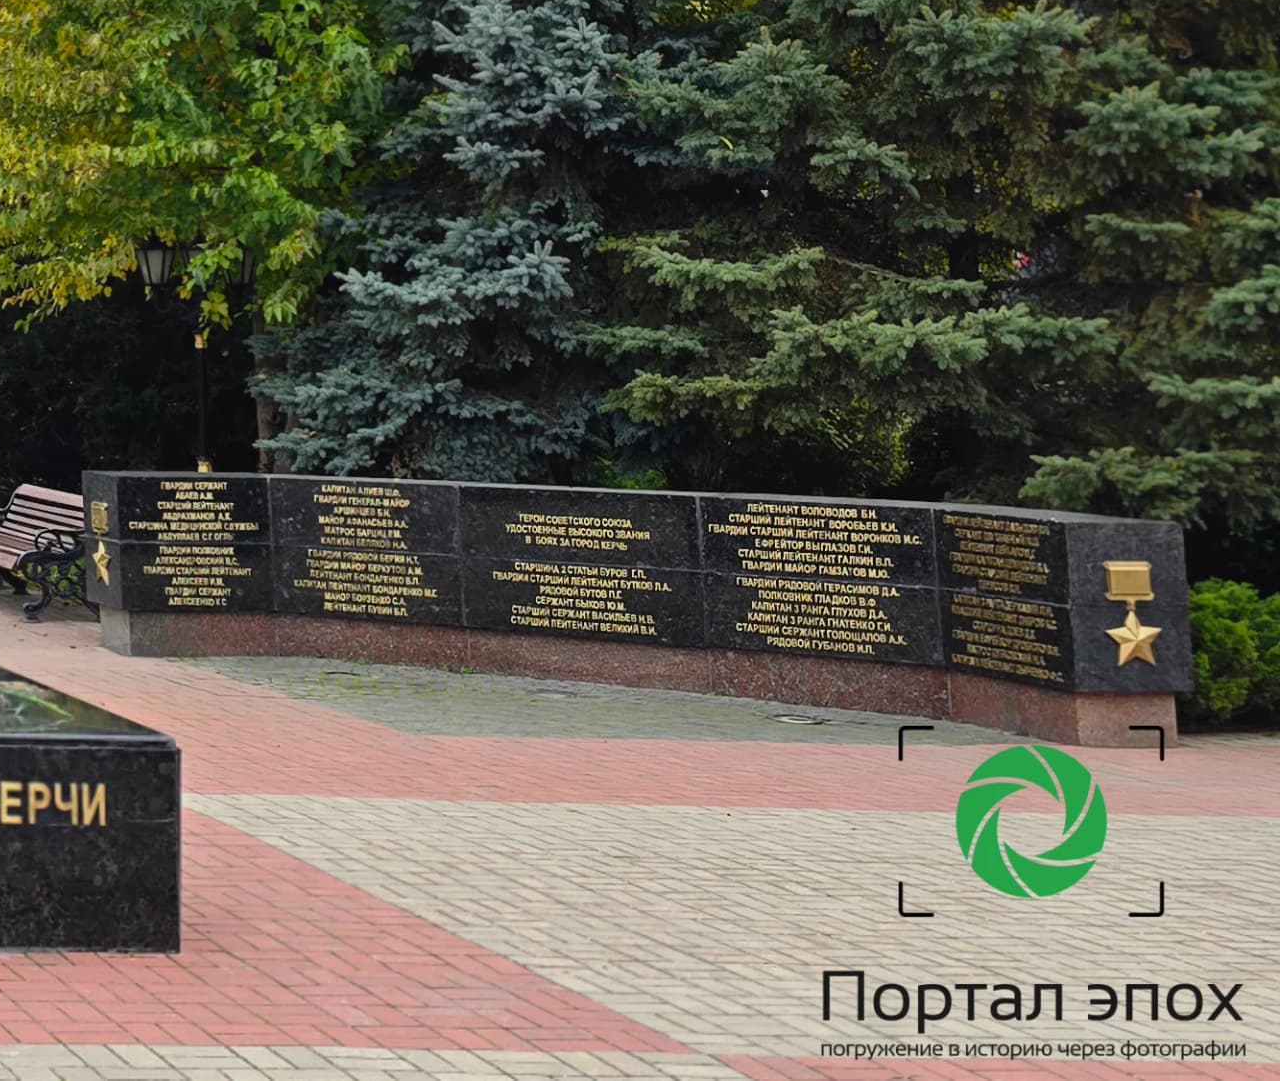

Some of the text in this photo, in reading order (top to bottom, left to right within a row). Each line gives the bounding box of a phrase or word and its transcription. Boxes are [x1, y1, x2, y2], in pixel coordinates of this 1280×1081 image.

[747, 503, 798, 515] ЛЕЙТЕНАНТ
[520, 514, 632, 527] ГЕРОИ СОВЕТСКОГО СОЮЗА
[729, 513, 898, 531] СТАРШИЙ ЛЕЙТЕНАНТ ВОРОБЬЕВ К.И.
[505, 525, 650, 539] УДОСТОЕННЫЕ ВЫСОКОГО ЗВАНИЯ
[708, 524, 922, 544] ГВАРДИИ СТАРШИЙ ЛЕЙТЕНАНТ ВОРОНКОВ И.С.
[525, 536, 627, 550] В БОЯХ ЗА ГОРОД КЕРЧЬ
[755, 538, 873, 554] ЕФРЕЙТОР ВЫГЛАЗОВ Г.И.
[738, 548, 781, 559] СТАРШИЙ
[783, 551, 835, 563] ЛЕЙТЕНАНТ
[838, 555, 873, 565] ГАЛКИН
[515, 563, 558, 573] СТАРШИНА
[568, 566, 598, 575] СТАТЬИ
[600, 568, 627, 577] БУРОВ
[742, 561, 890, 578] ГВАРДИИ МАЙОР ГАМЗАТОВ М.Ю.
[493, 572, 529, 583] ГВАРДИИ
[530, 574, 569, 585] СТАРШИЙ
[571, 577, 619, 588] ЛЕЙТЕНАНТ
[621, 580, 653, 590] БУТКОВ
[736, 577, 900, 597] ГВАРДИИ РЯДОВОЙ ГЕРАСИМОВ Д.А.
[540, 586, 578, 597] РЯДОВОЙ
[580, 589, 607, 598] БУТОВ
[759, 591, 813, 602] ПОЛКОВНИК
[815, 594, 857, 606] ГЛАДКОВ
[536, 596, 573, 607] СЕРЖАНТ
[575, 599, 605, 609] БЫКОВ
[752, 601, 791, 612] КАПИТАН
[794, 604, 799, 613] 3
[801, 605, 830, 615] РАНГА
[832, 607, 866, 617] ГЛУХОВ
[512, 605, 550, 616] СТАРШИЙ
[552, 609, 590, 619] СЕРЖАНТ
[592, 612, 636, 623] ВАСИЛЬЕВ
[748, 613, 788, 623] КАПИТАН
[791, 616, 795, 624] 3
[797, 616, 825, 626] РАНГА
[828, 618, 875, 630] ГНАТЕНКО
[511, 615, 549, 627] СТАРШИЙ
[551, 619, 598, 630] ЛЕЙТЕНАНТ
[600, 622, 639, 634] ВЕЛИКИЙ
[736, 622, 779, 634] СТАРШИЙ
[782, 627, 825, 638] СЕРЖАНТ
[827, 630, 886, 644] ГОЛОЩАПОВ
[767, 636, 810, 649] РЯДОВОЙ
[812, 641, 855, 652] ГУБАНОВ
